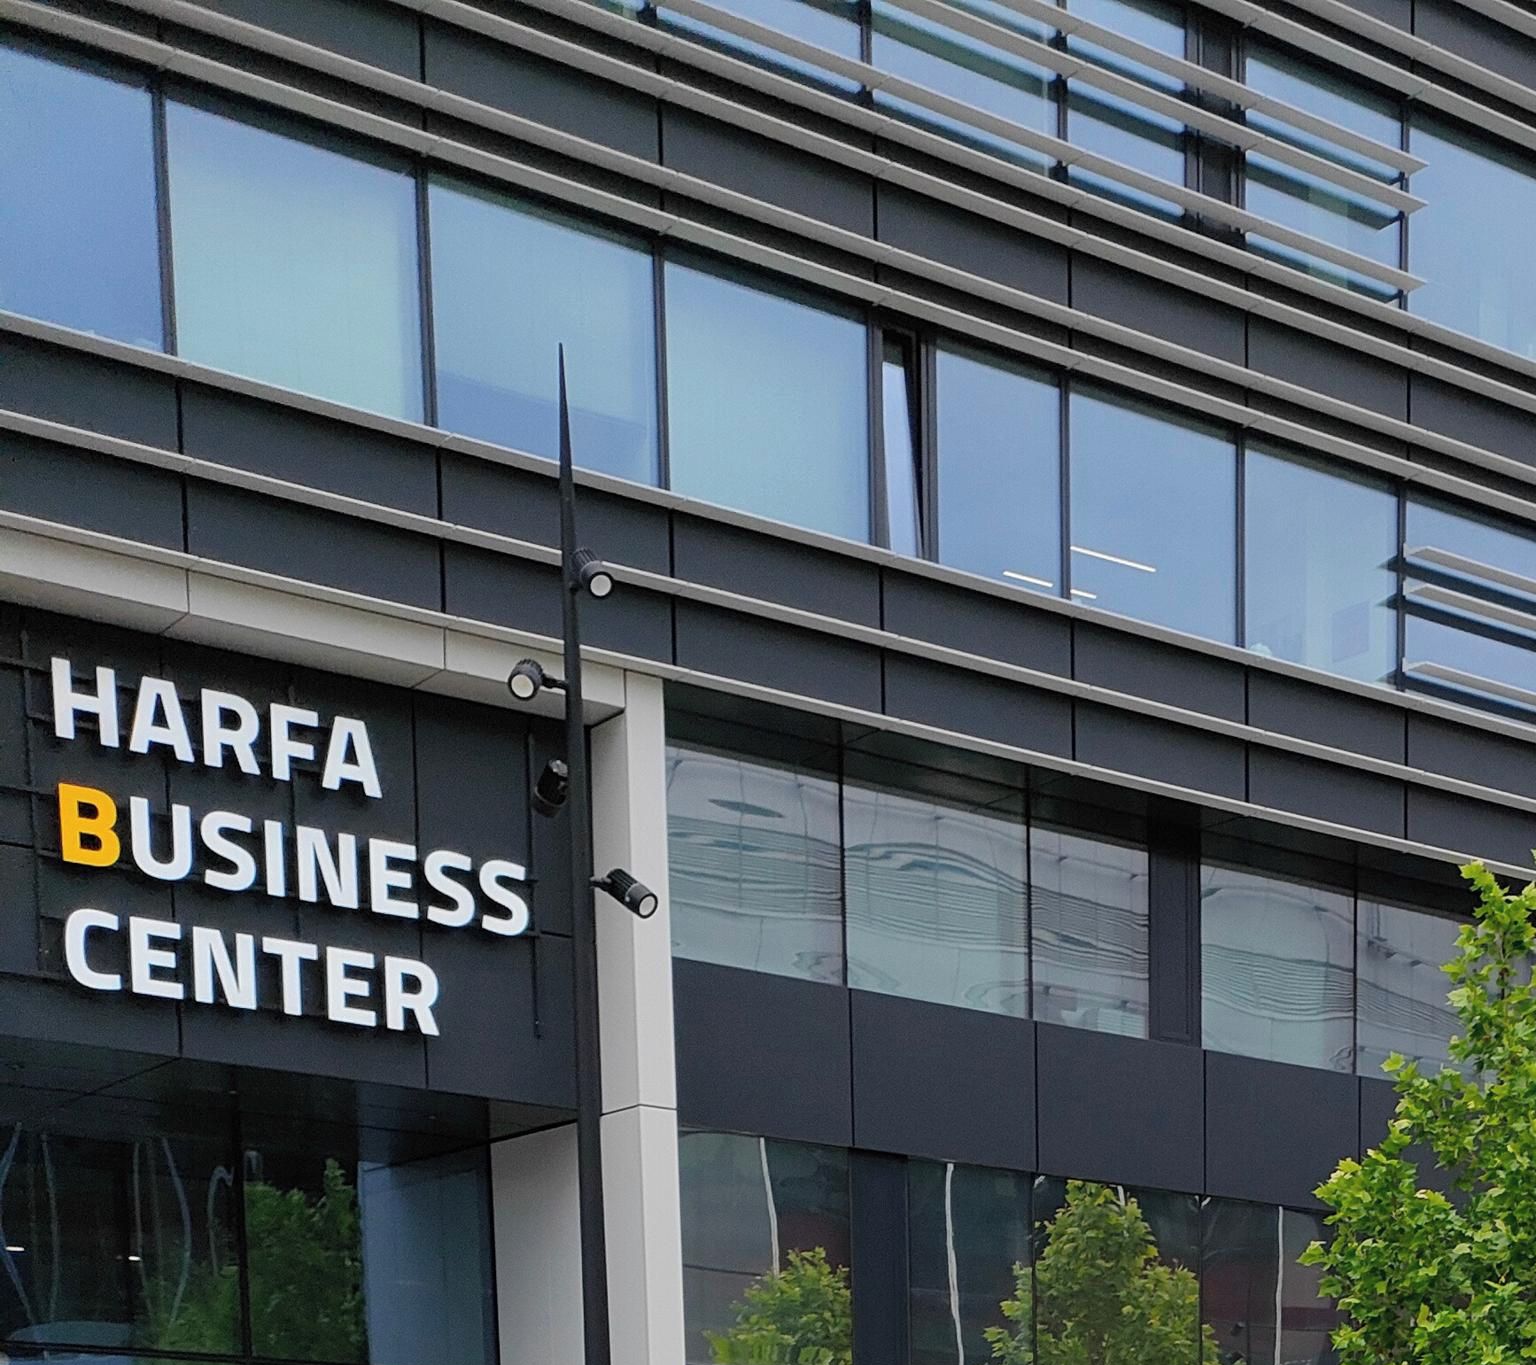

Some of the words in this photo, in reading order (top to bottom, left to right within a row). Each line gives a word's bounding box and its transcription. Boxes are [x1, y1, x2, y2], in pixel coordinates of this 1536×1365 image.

[51, 656, 383, 799] HARFA
[57, 782, 531, 937] BUSINESS
[64, 908, 440, 1037] CENTER
